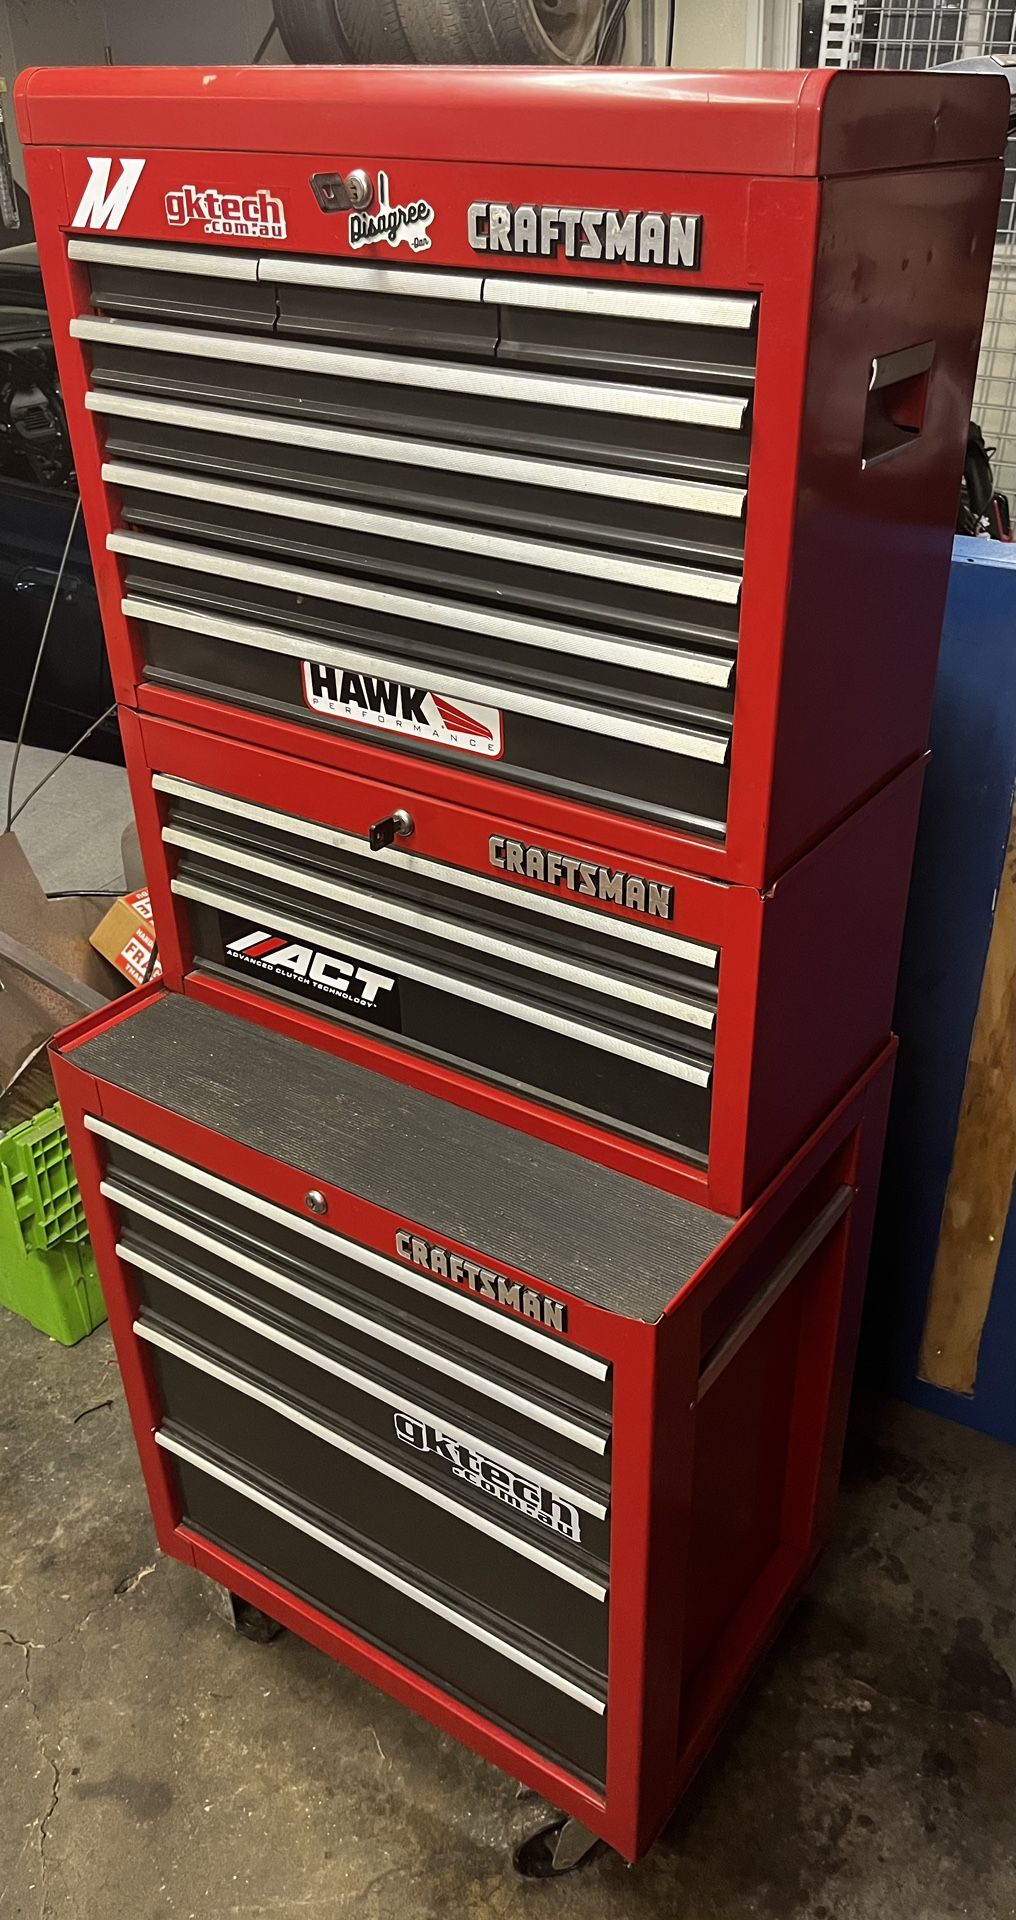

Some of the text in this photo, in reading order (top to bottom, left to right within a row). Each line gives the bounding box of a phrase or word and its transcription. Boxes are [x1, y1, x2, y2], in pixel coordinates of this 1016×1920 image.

[165, 186, 284, 226] gktech
[350, 202, 431, 243] Disagree
[467, 201, 702, 270] CRAFTSMAN
[309, 662, 430, 726] HAWK
[312, 698, 495, 751] PERFORMANCE
[489, 834, 674, 920] CRAFTSMAN
[226, 950, 377, 1008] ADVANCED CLUTCH TECHNOLOGY
[261, 943, 395, 1002] ACT
[396, 1229, 568, 1333] CRAFTSMAN
[394, 1413, 579, 1530] gktech
